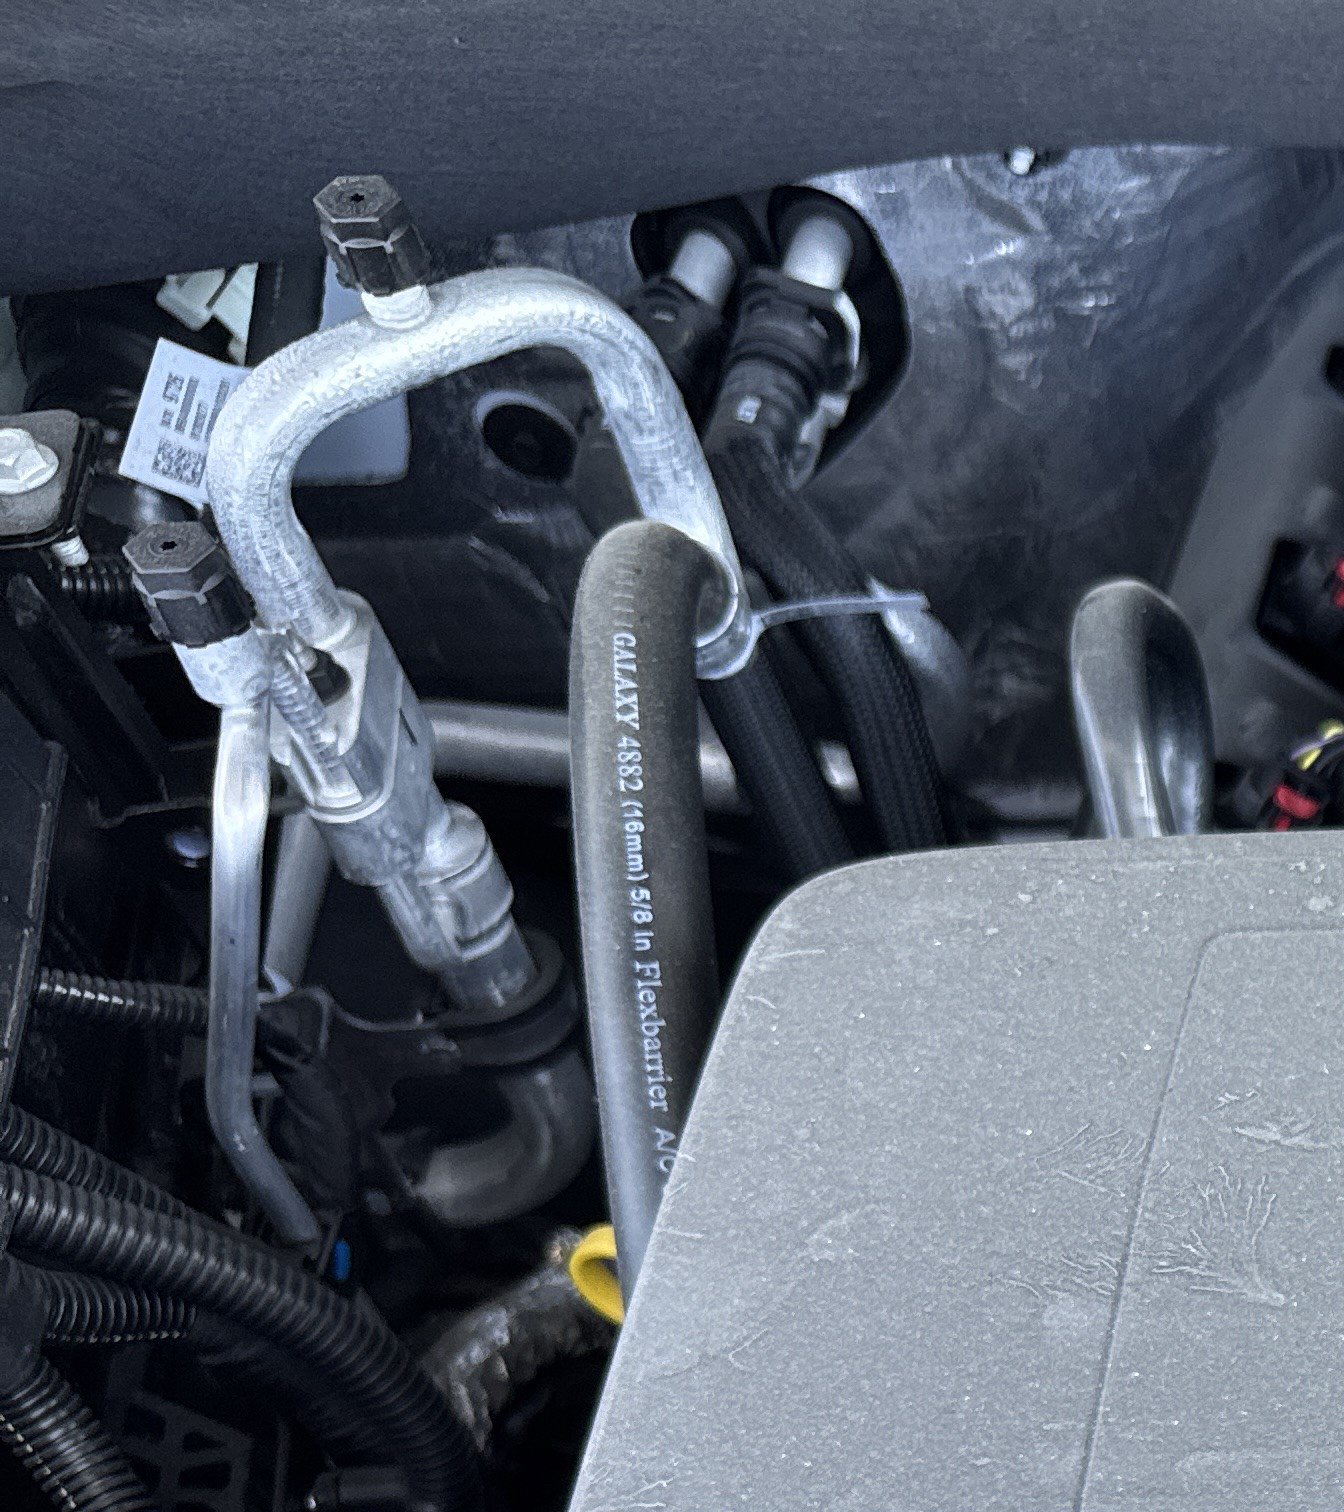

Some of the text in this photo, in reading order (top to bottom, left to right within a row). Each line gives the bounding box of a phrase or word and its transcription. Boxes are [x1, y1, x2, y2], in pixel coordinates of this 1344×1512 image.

[612, 632, 640, 730] GALAXY
[617, 735, 644, 792] 4882
[622, 799, 649, 881] (16mm)
[630, 887, 654, 924] 5/8
[635, 960, 674, 1112] Flexbarrier
